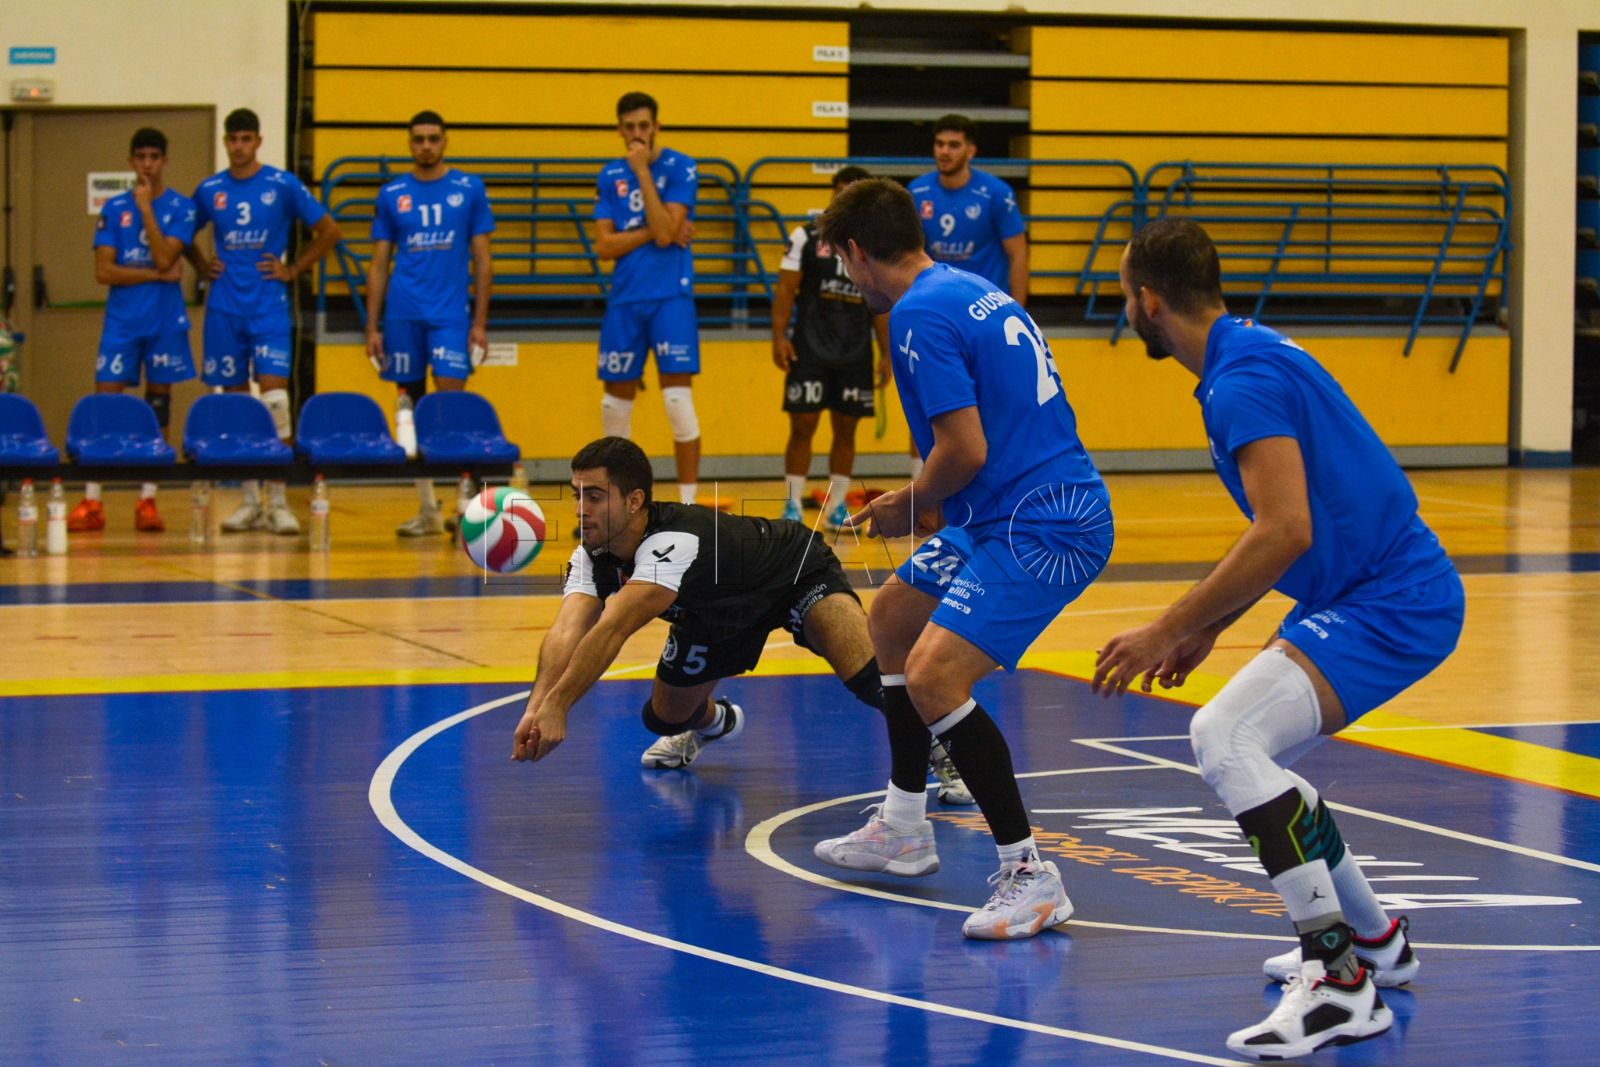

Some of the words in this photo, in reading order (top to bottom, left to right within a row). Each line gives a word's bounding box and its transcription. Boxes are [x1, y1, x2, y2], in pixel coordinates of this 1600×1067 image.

[236, 201, 251, 226] 3
[418, 203, 442, 227] 11
[940, 213, 955, 237] 9
[110, 353, 124, 375] 6
[221, 355, 236, 378] 3
[394, 352, 410, 374] 11
[607, 351, 635, 374] 87
[803, 381, 823, 403] 10
[911, 537, 960, 586] 24
[682, 644, 709, 676] 5
